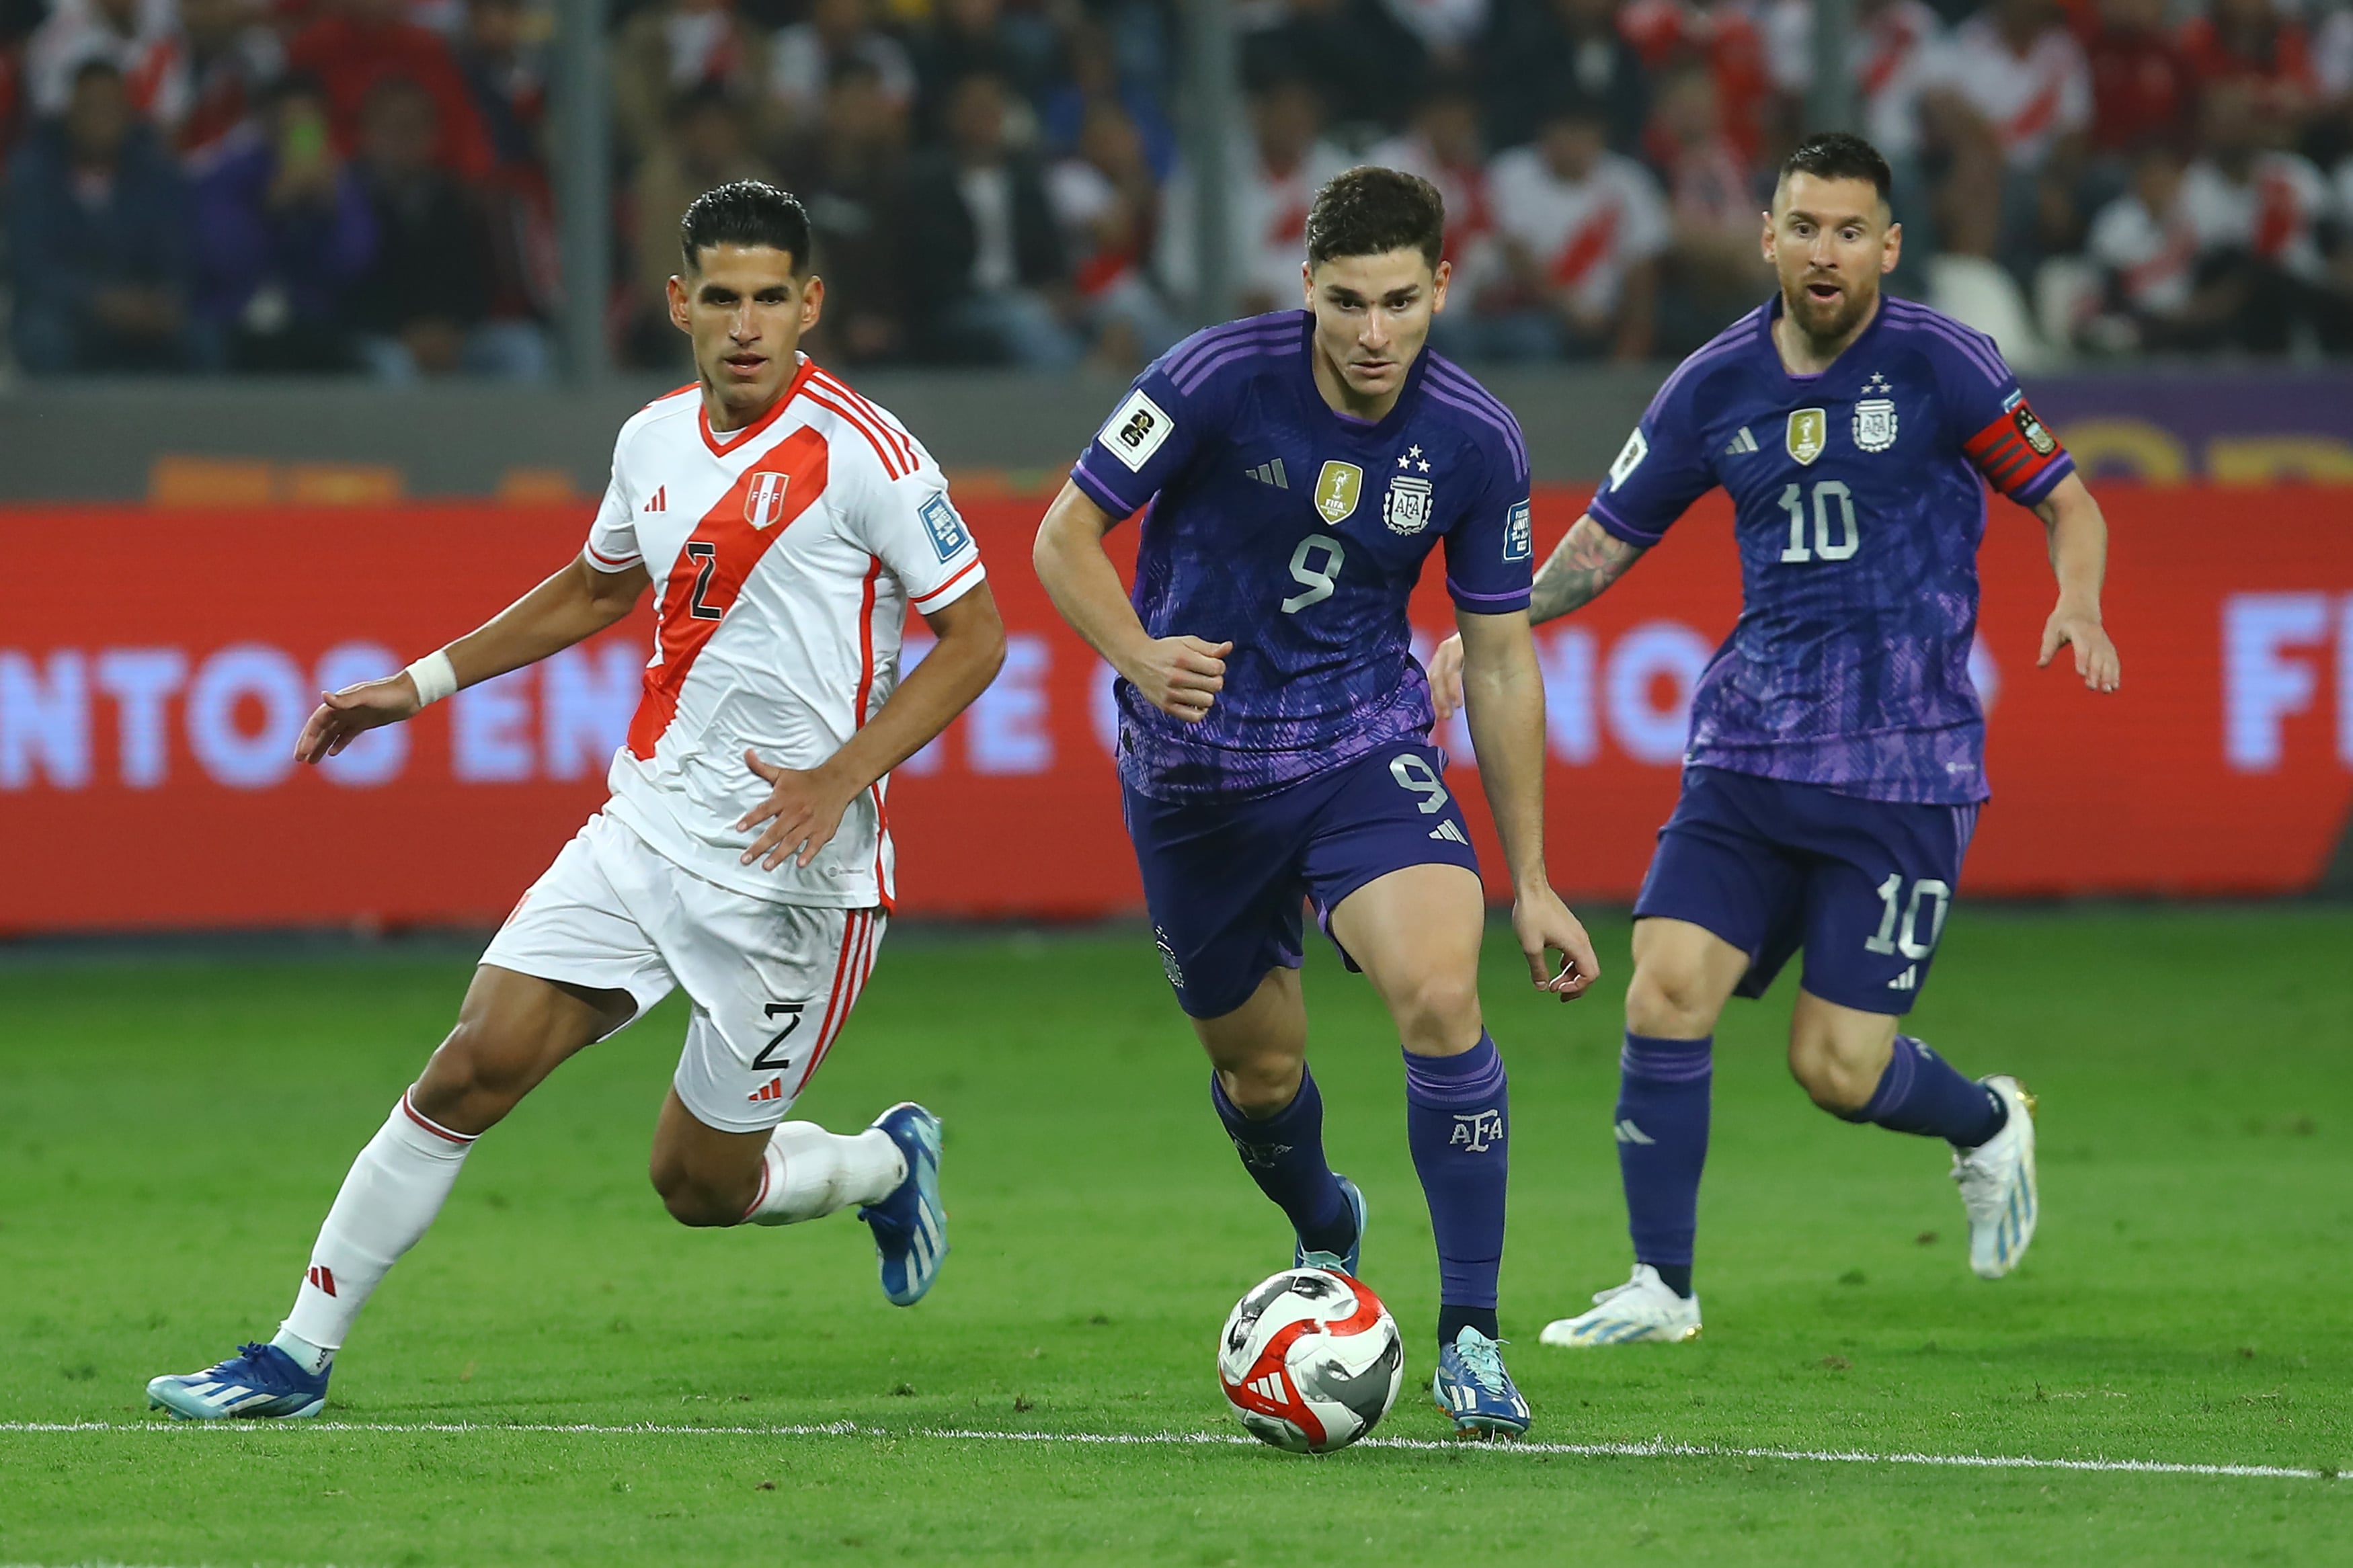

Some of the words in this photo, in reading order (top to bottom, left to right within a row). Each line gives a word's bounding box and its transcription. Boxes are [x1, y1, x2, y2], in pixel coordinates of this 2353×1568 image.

[1325, 498, 1344, 509] FIFA
[1394, 491, 1420, 520] AFA
[1778, 480, 1859, 563] 10
[686, 541, 722, 621] 2
[1281, 533, 1346, 614] 9
[1389, 753, 1448, 815] 9
[1864, 873, 1951, 960] 10
[751, 1003, 805, 1071] 2
[1449, 1109, 1503, 1152] AFA
